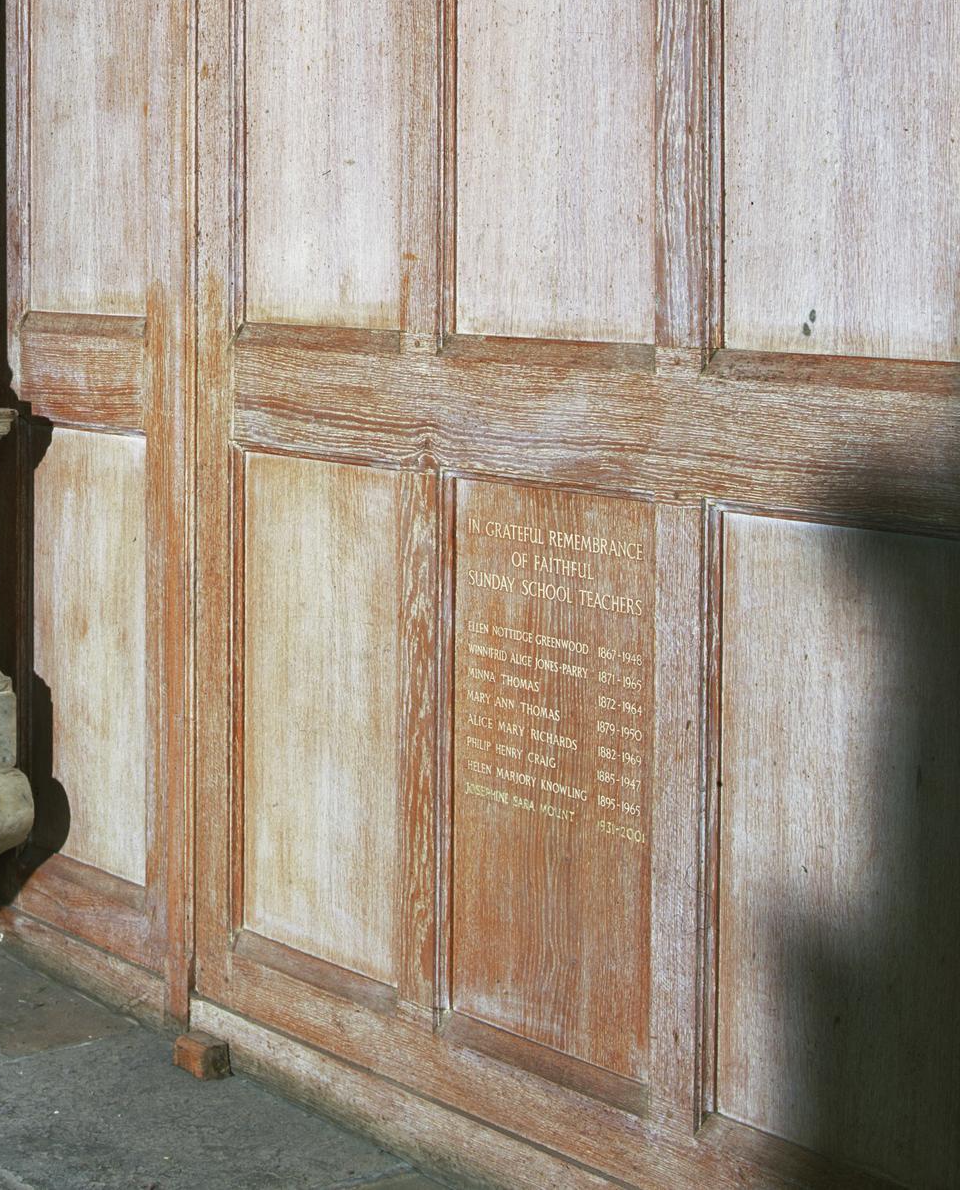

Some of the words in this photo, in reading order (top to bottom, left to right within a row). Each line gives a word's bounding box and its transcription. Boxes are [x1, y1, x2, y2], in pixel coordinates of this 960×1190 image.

[468, 518, 480, 534] IN
[485, 521, 544, 545] GRATEFUL
[549, 530, 643, 561] REMEMBRANCE
[511, 551, 528, 568] OF
[534, 555, 594, 580] FAITHFUL
[468, 570, 515, 592] SUNDAY
[521, 579, 572, 603] SCHOOL
[579, 589, 642, 616] TEACHERS
[468, 620, 489, 634] ELLEN
[492, 625, 533, 643] NOTTIDGE
[535, 634, 589, 655] GREENWOOD
[598, 646, 642, 666] 1867-1948
[468, 643, 507, 661] WINNIFRID
[510, 653, 532, 667] ALICE
[534, 658, 588, 679] JONES-PARRY
[598, 671, 642, 692] 1871-1965
[467, 690, 491, 705] MARY
[494, 697, 515, 709] ANN
[520, 702, 561, 722] THOMAS
[597, 720, 642, 741] 1879-1950
[468, 668, 496, 683] MINNA
[501, 674, 540, 692] THOMAS
[598, 695, 642, 716] 1872-1964
[467, 714, 493, 730] ALICE
[497, 721, 525, 737] MARY
[530, 729, 578, 751] RICHARDS
[598, 746, 642, 767] 1882-1969
[467, 736, 492, 752] PHILIP
[496, 744, 523, 760] HENRY
[527, 752, 556, 769] CRAIG
[597, 770, 641, 792] 1885-1947
[465, 782, 509, 805] JOSEPHINE
[513, 795, 536, 812] SARA
[540, 803, 575, 822] MOUNT
[467, 760, 492, 776] HELEN
[496, 767, 537, 788] MARJORY
[541, 779, 587, 802] KNOWLING
[597, 795, 641, 817] 1895-1965
